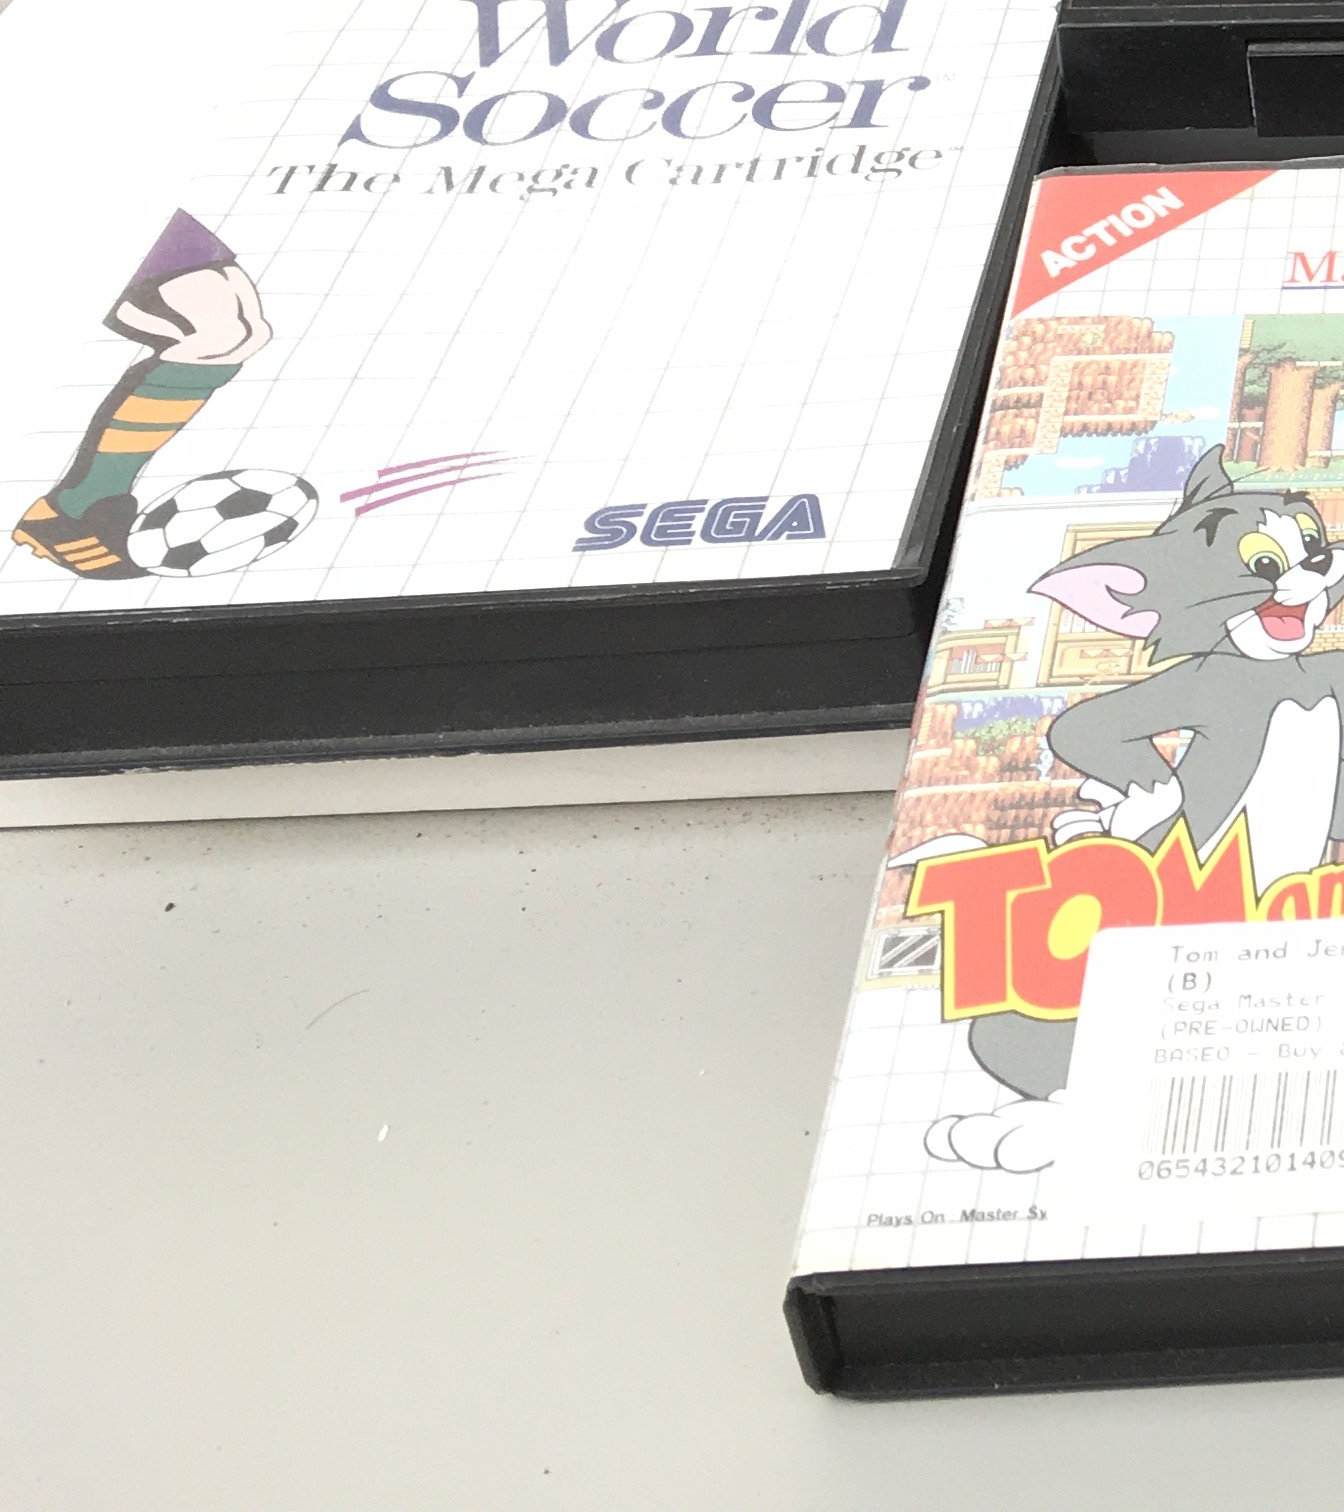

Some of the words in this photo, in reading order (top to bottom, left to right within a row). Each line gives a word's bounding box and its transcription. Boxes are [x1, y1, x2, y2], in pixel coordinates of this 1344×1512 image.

[339, 70, 931, 150] Soccer
[267, 163, 401, 197] The
[423, 159, 599, 203] Mega
[624, 145, 948, 189] Cartridge
[1039, 185, 1186, 279] ACTION
[571, 493, 826, 552] SEGA
[1170, 945, 1219, 964] Tom
[1237, 942, 1288, 961] and
[1167, 971, 1212, 994] (B)
[1163, 996, 1220, 1015] Sega
[1239, 992, 1325, 1009] Master
[1161, 1016, 1321, 1039] (PRE-OWNED)
[1278, 1043, 1321, 1060] Buy
[867, 1213, 913, 1228] Plays
[921, 1210, 945, 1224] On
[960, 1208, 1018, 1222] Master
